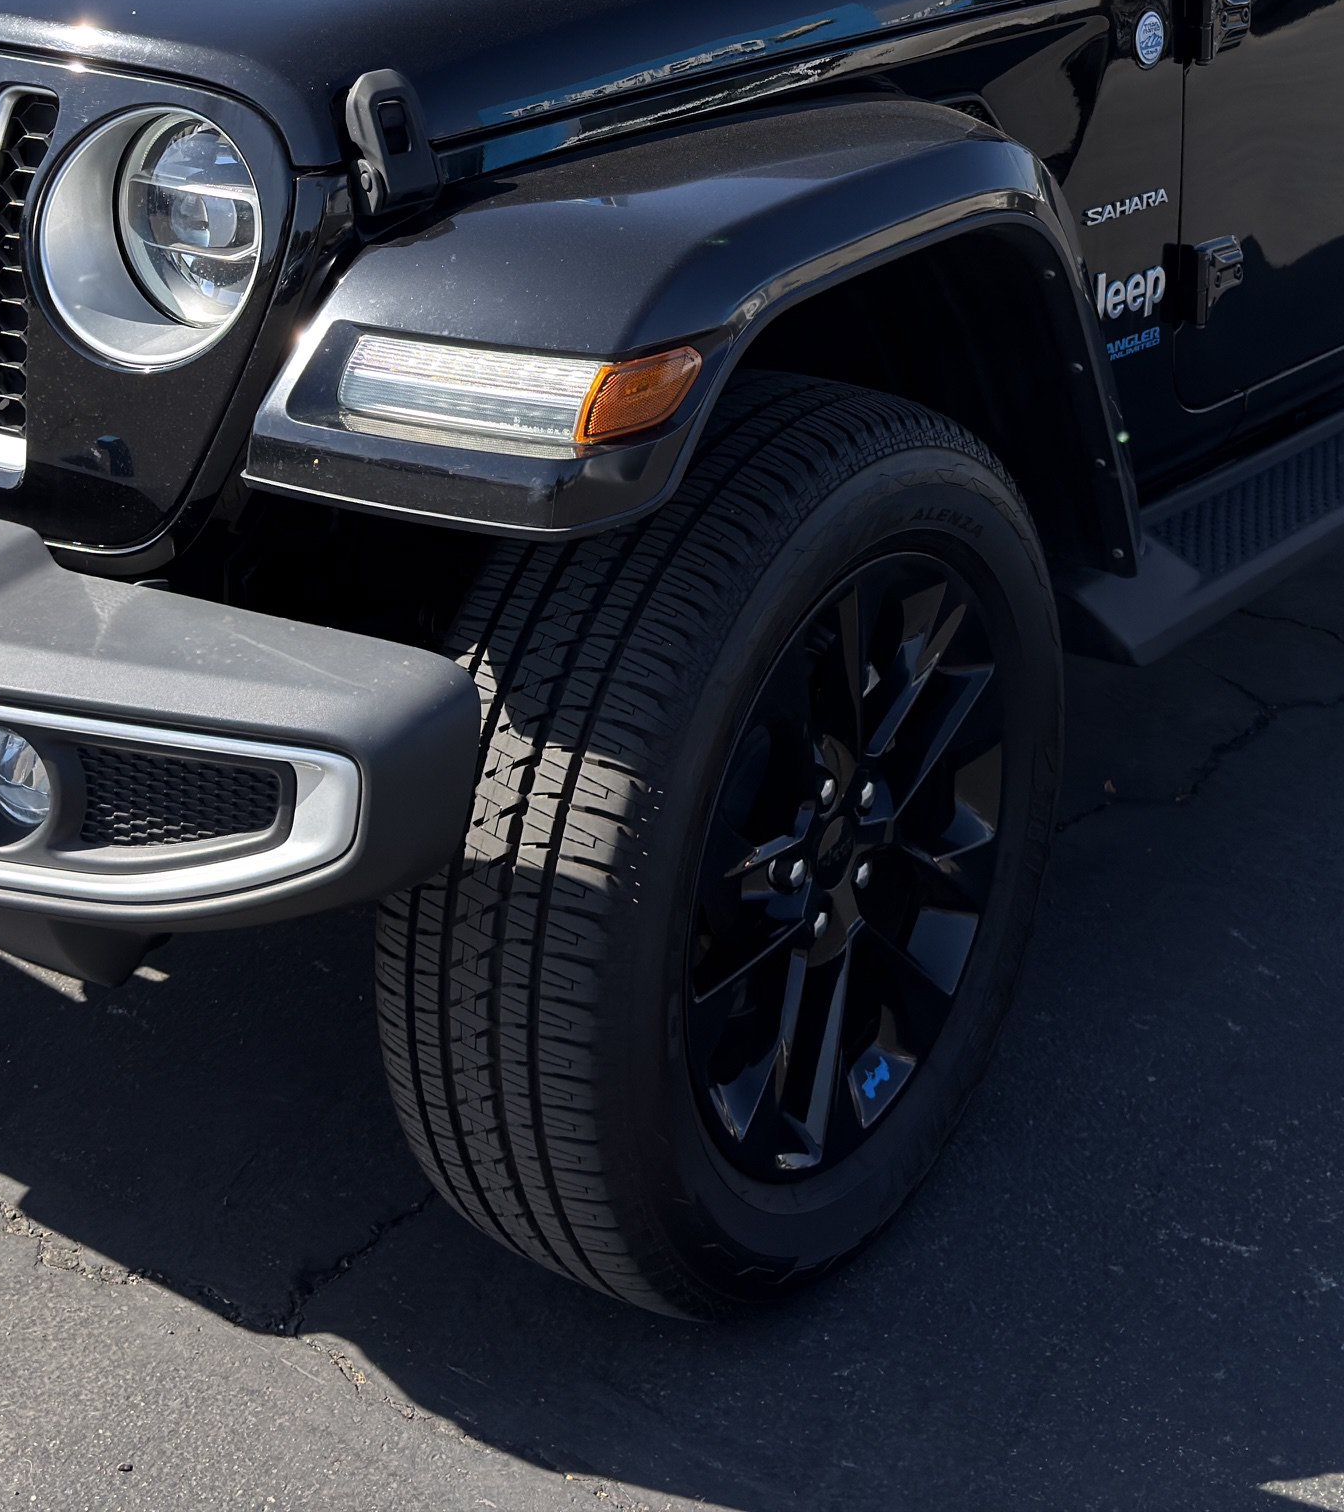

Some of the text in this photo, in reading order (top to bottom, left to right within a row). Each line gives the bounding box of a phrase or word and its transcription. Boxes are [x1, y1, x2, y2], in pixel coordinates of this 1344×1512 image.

[1084, 187, 1169, 227] SAHARA
[1096, 265, 1166, 320] Jeep
[1106, 326, 1160, 354] ANGLER
[1110, 338, 1160, 361] NLIMITED
[909, 506, 984, 538] ALENZA
